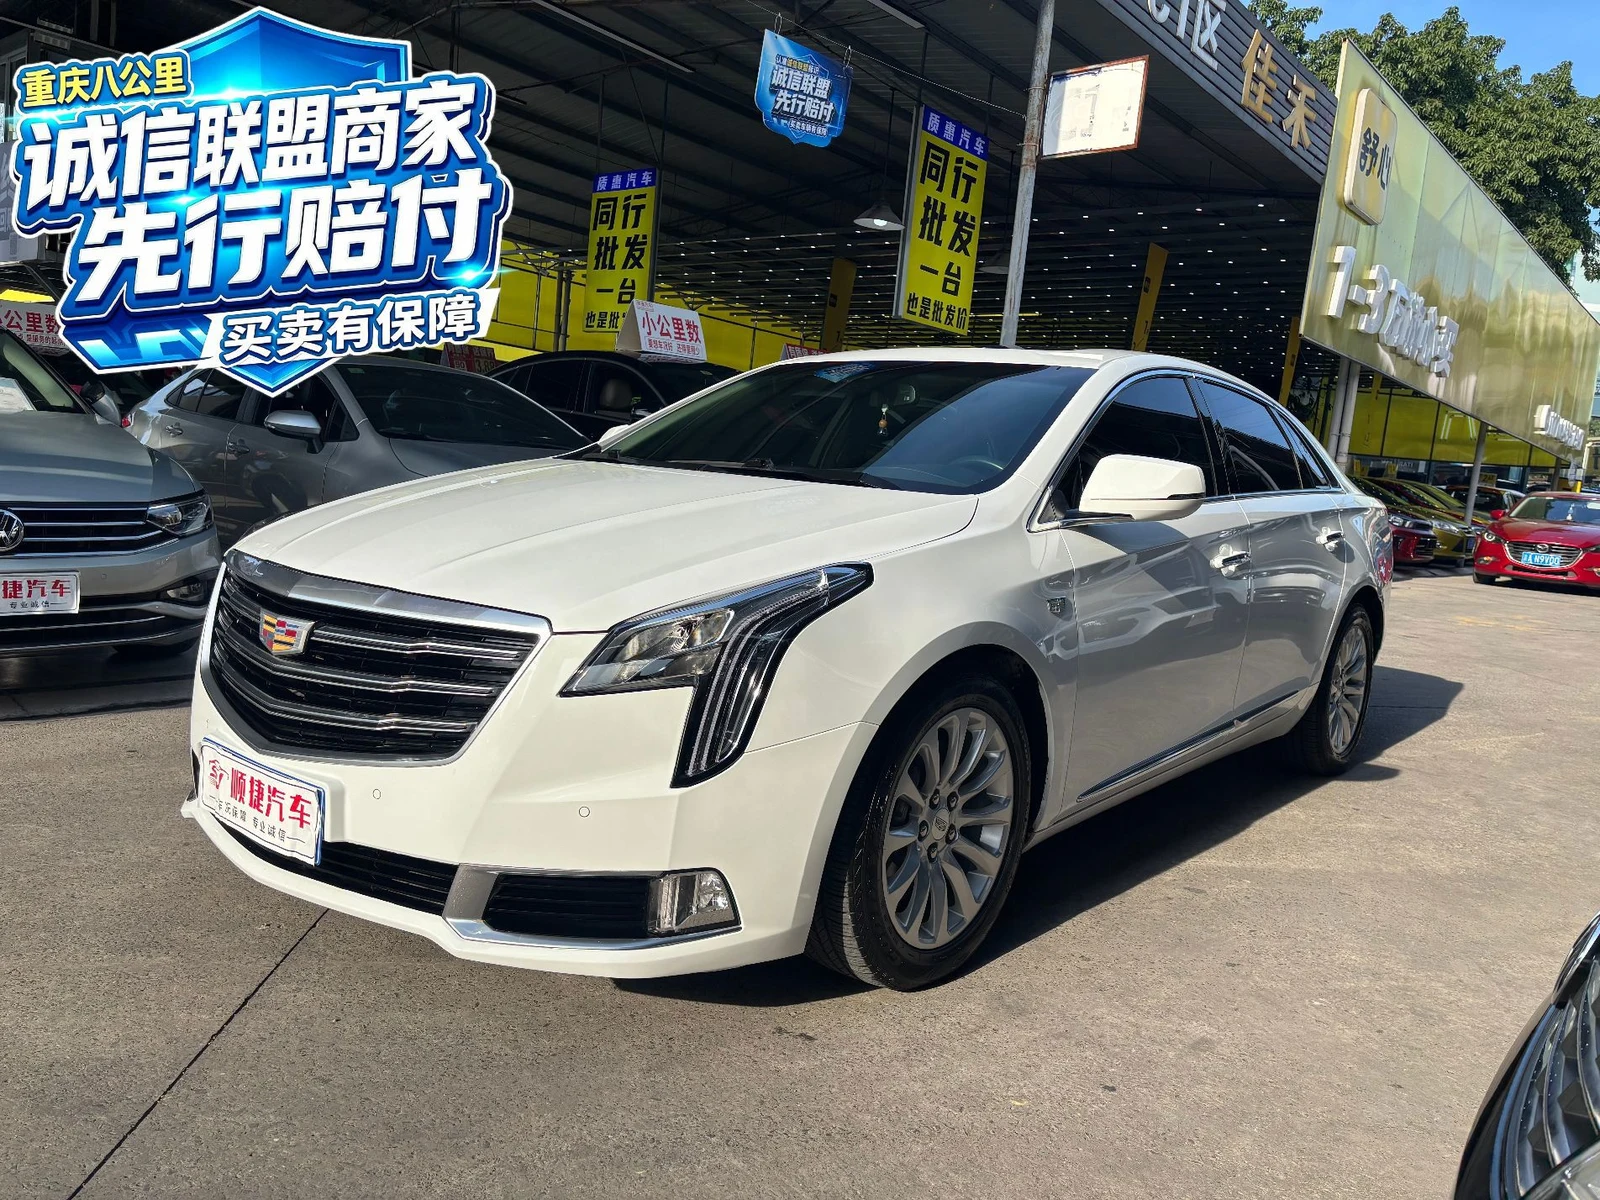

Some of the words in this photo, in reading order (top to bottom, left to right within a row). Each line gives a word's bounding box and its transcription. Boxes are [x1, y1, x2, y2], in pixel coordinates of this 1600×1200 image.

[770, 65, 831, 99] 诚信联盟
[1240, 29, 1317, 149] 佳禾
[774, 89, 835, 122] 先行赔付
[927, 112, 985, 155] 质惠汽车
[920, 140, 978, 203] 同行
[1359, 126, 1391, 190] 舒心
[597, 171, 653, 191] 质惠汽车
[592, 193, 647, 230] 同行
[918, 195, 976, 257] 批发
[593, 234, 648, 270] 批发
[596, 278, 636, 304] 一台
[920, 261, 961, 297] 一台
[0, 309, 61, 334] 公里数
[585, 311, 626, 329] 也是批
[642, 311, 701, 344] 小公里数
[906, 292, 968, 330] 也是批发价
[2, 579, 71, 598] 捷汽车
[230, 767, 311, 828] 顺捷汽车
[252, 816, 286, 842] 专业诚信
